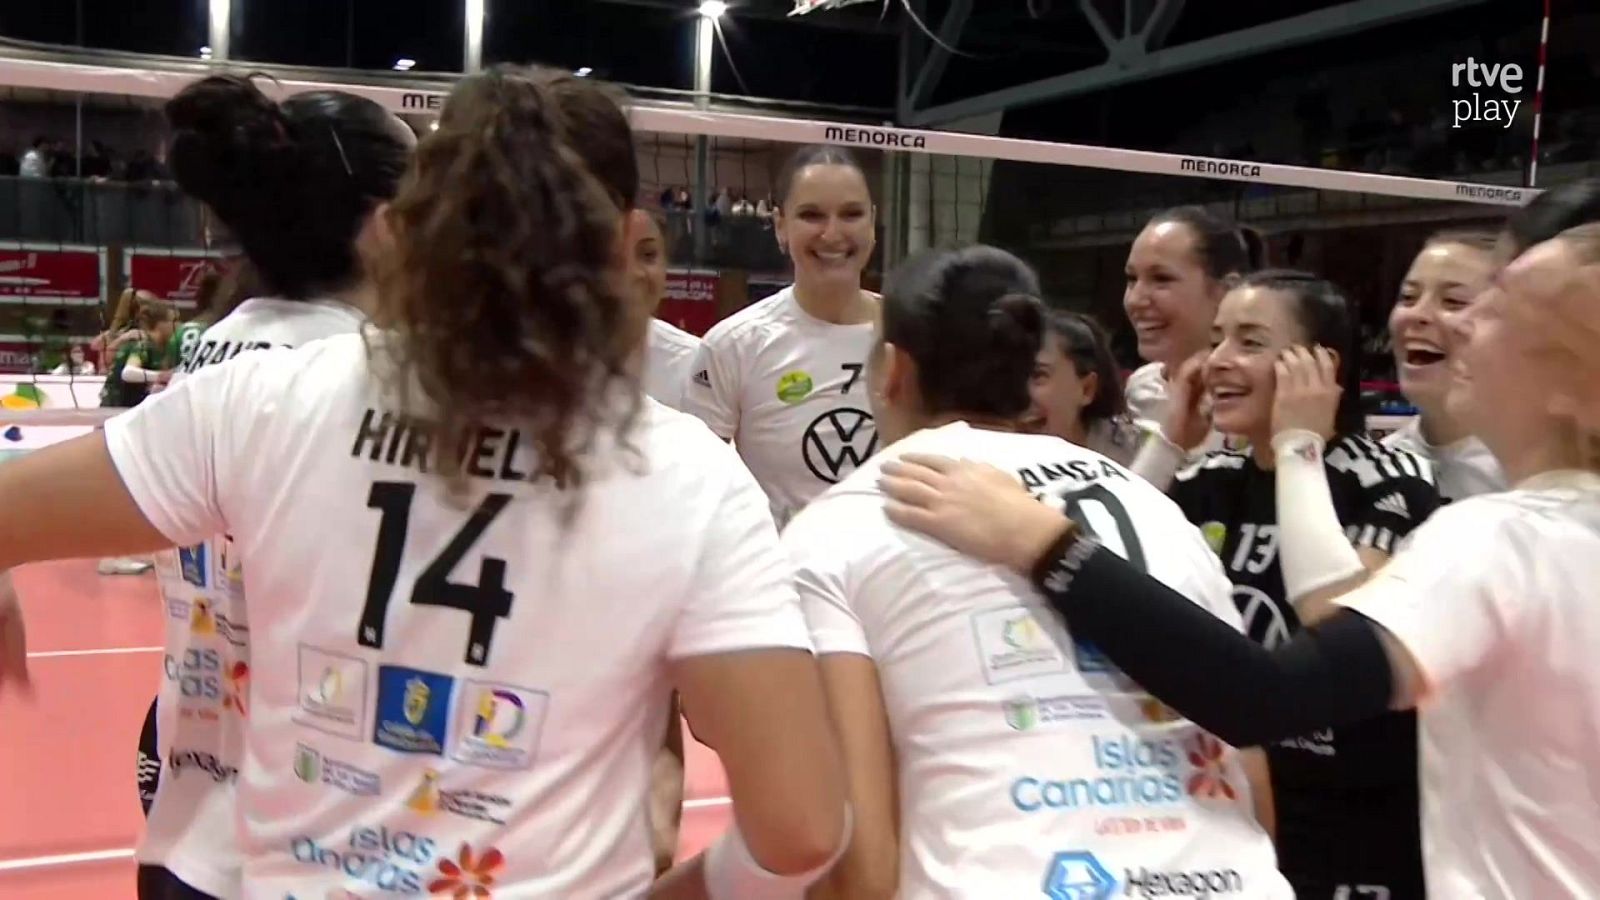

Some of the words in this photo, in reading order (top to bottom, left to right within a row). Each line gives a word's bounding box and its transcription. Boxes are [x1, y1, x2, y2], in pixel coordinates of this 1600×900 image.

[402, 93, 440, 109] ME
[825, 127, 926, 148] MENORCA
[1180, 158, 1261, 178] MENORCA
[840, 363, 864, 394] 7
[1016, 459, 1130, 492] ANCA
[1231, 522, 1280, 574] 13
[358, 481, 514, 667] 14
[1092, 734, 1180, 773] Islas
